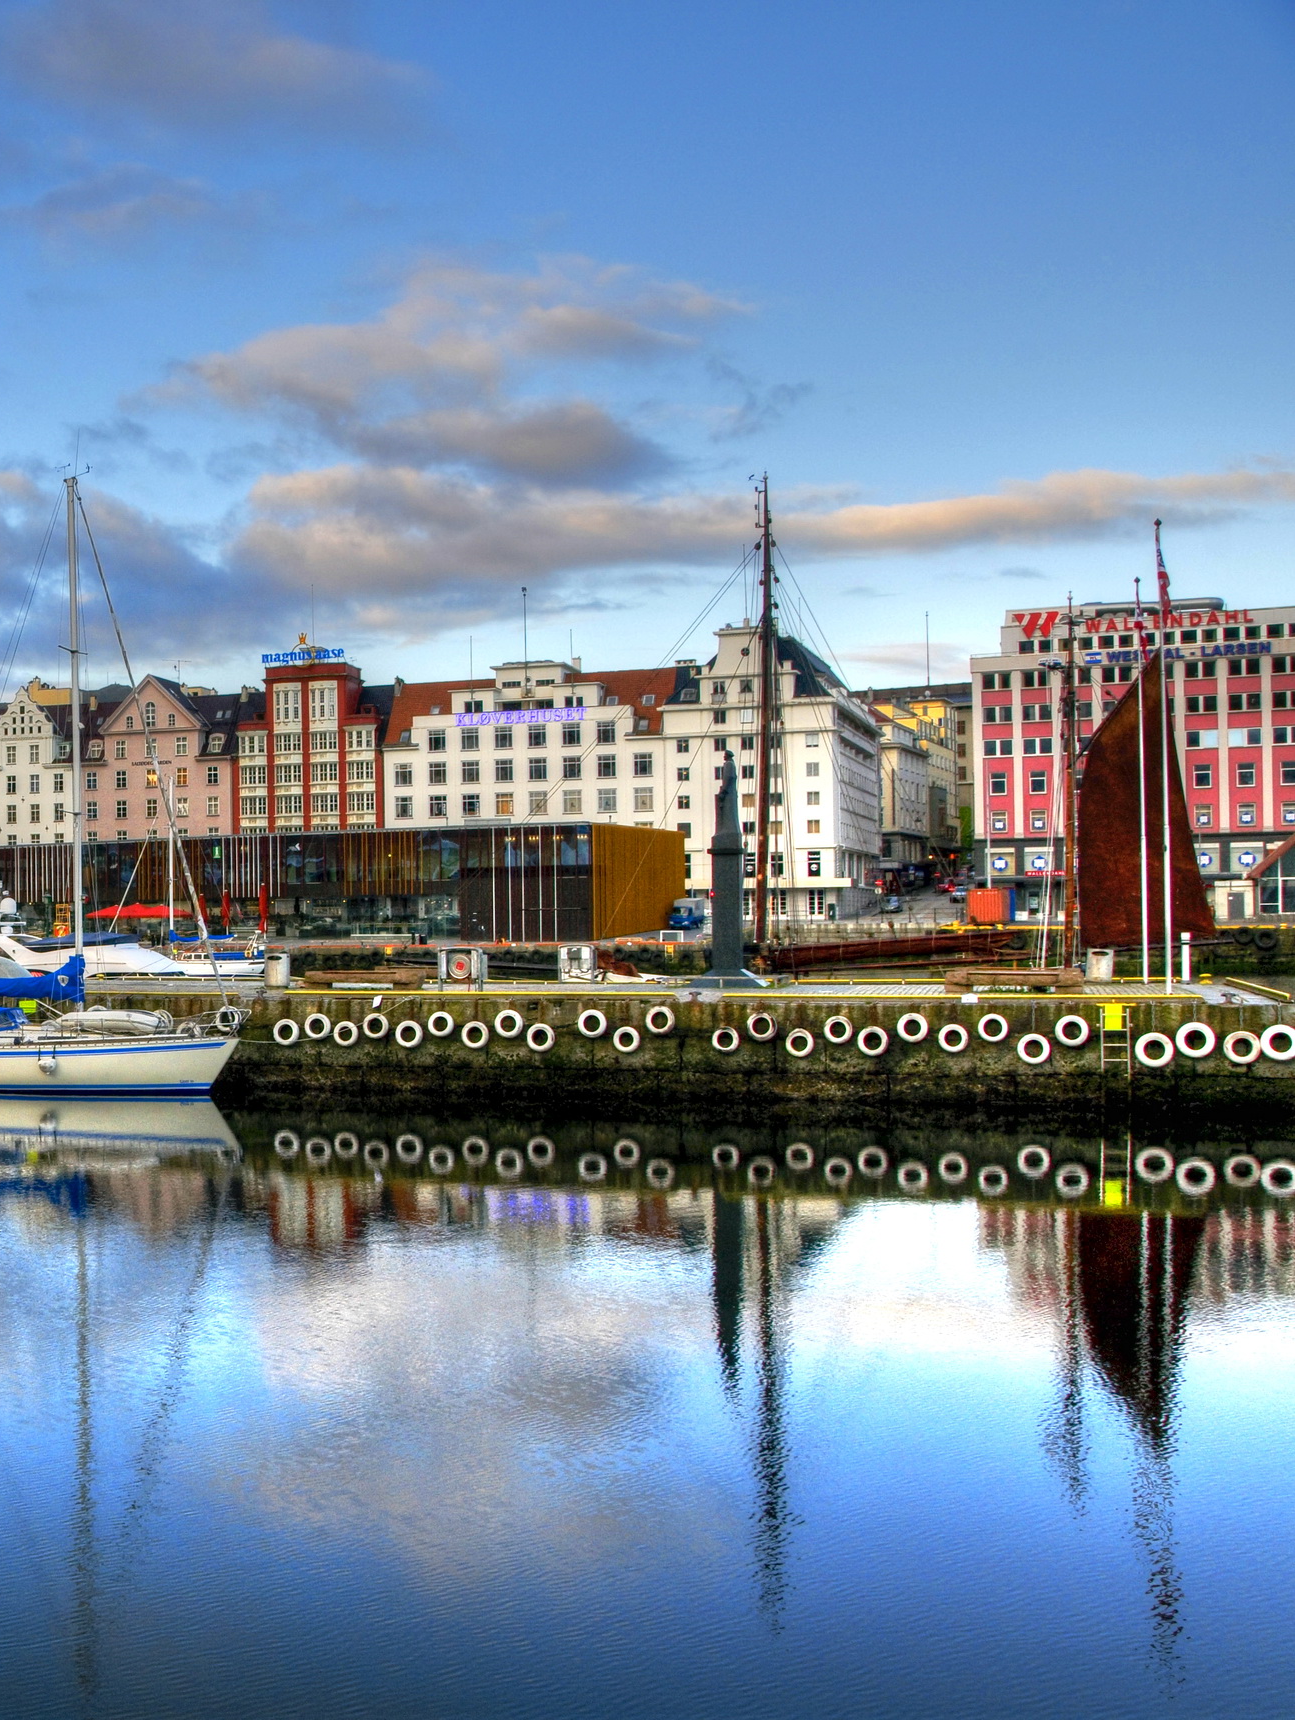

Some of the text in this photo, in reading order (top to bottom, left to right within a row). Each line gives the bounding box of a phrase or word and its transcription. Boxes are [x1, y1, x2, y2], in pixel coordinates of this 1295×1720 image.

[1085, 609, 1254, 632] WALENDAHL
[261, 648, 345, 665] magnus aase
[1201, 641, 1272, 657] LARSEN
[455, 706, 587, 727] KLØVERHUSET
